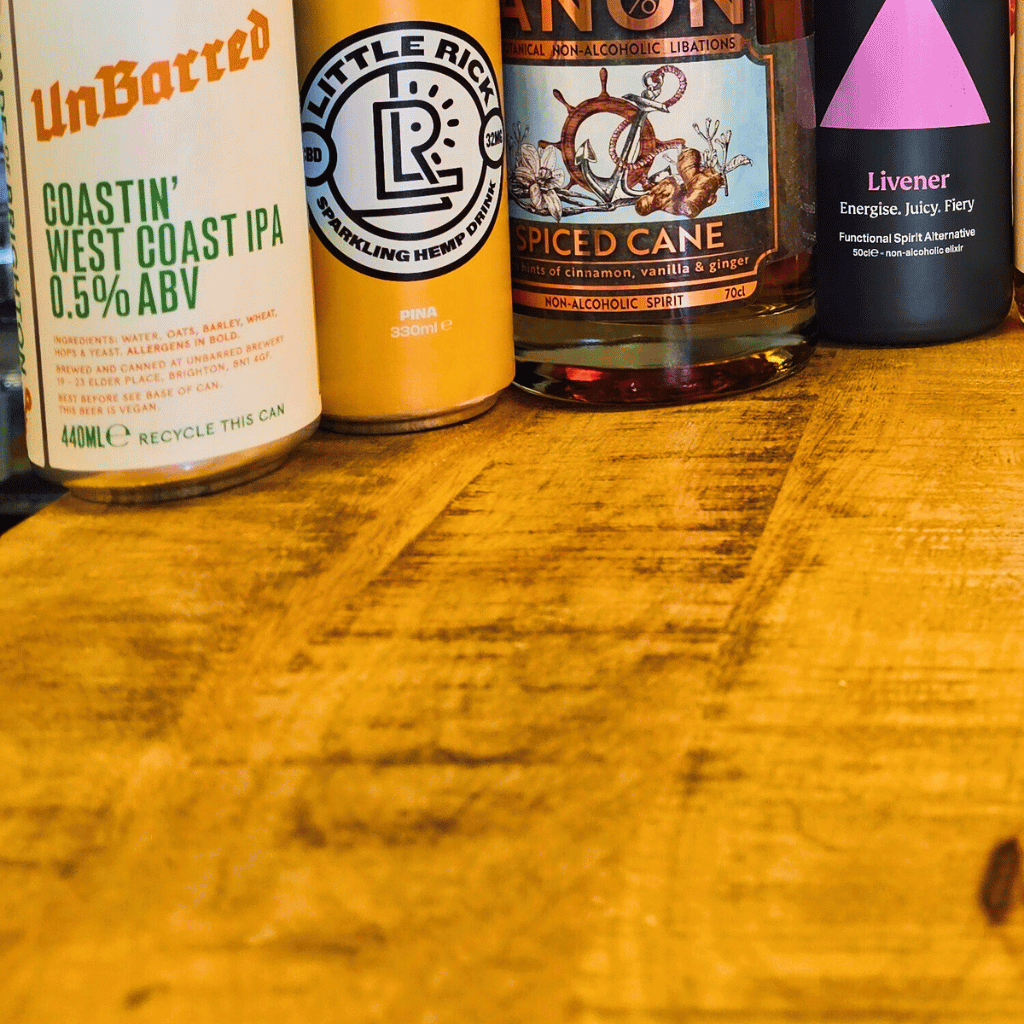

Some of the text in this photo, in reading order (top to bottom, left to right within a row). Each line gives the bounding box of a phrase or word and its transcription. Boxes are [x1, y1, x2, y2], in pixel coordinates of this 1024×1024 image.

[552, 42, 660, 57] NON-ALCOHOLIC
[670, 37, 736, 54] LIBATIONS
[31, 8, 270, 142] UnBarred
[307, 36, 495, 119] LITTLE RICK
[868, 170, 950, 191] Livener
[42, 176, 178, 226] COASTIN'
[840, 198, 975, 218] Energise. Juicy. Fiery
[316, 179, 496, 262] SPARKLING HEMP DRINK
[45, 204, 284, 273] WEST COAST IPA
[516, 221, 725, 258] SPICED CANE
[839, 227, 976, 245] Functional Spirit Alternative
[886, 244, 964, 257] non-alcoholic elixir
[550, 265, 561, 276] of
[565, 266, 636, 279] cinnamon,
[640, 263, 690, 277] vanilla
[694, 262, 704, 273] &
[709, 256, 750, 275] ginger
[49, 266, 199, 319] 0.5% ABV
[545, 286, 746, 310] NON-ALCOHOLIC SPIRIT 70cl
[399, 306, 438, 322] PINA
[96, 364, 117, 374] AND
[120, 360, 167, 374] CANNED
[170, 358, 182, 368] AT
[187, 346, 243, 365] UNBARRED
[246, 335, 285, 353] BREWERY
[127, 340, 191, 356] ALLERGENS
[194, 337, 205, 348] IN
[89, 376, 121, 387] ELDER
[58, 393, 77, 404] BEST
[81, 393, 119, 404] BEFORE
[122, 392, 141, 402] SEE
[146, 388, 173, 400] BASE
[178, 385, 192, 396] OF
[139, 422, 215, 446] RECYCLE
[221, 413, 254, 432] THIS
[259, 403, 285, 422] CAN
